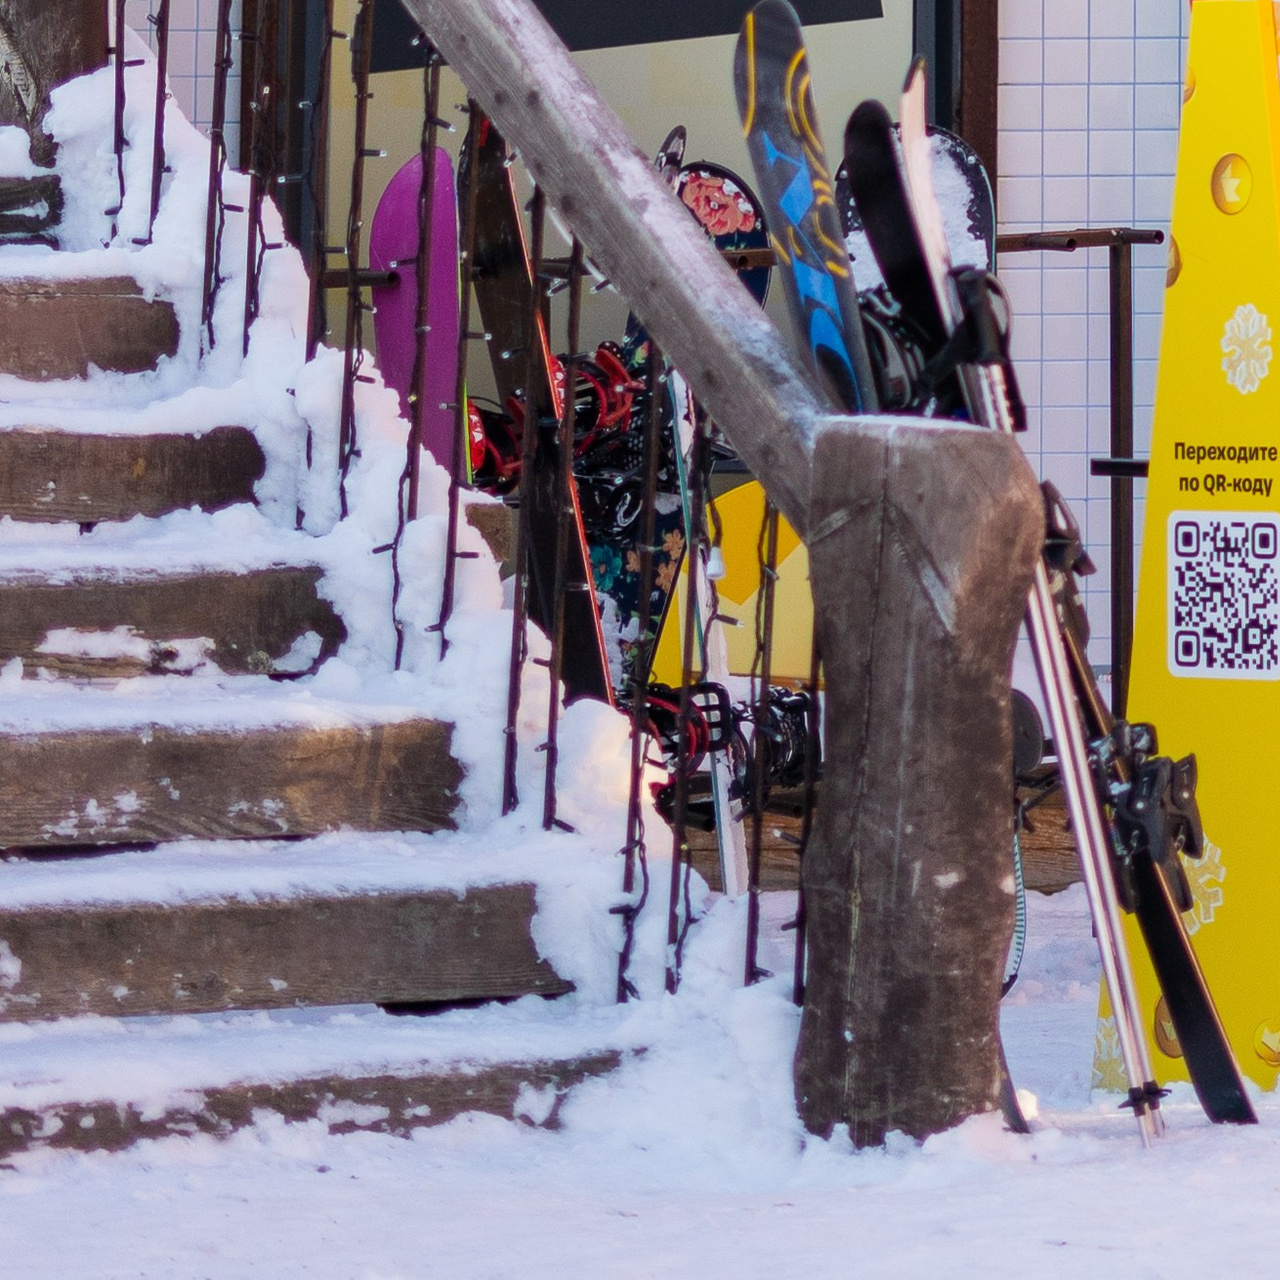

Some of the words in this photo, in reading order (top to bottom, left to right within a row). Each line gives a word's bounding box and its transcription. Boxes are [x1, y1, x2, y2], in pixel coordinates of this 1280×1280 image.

[1174, 441, 1279, 465] Переходите
[1178, 476, 1200, 492] по
[1202, 473, 1274, 498] QR-коду
